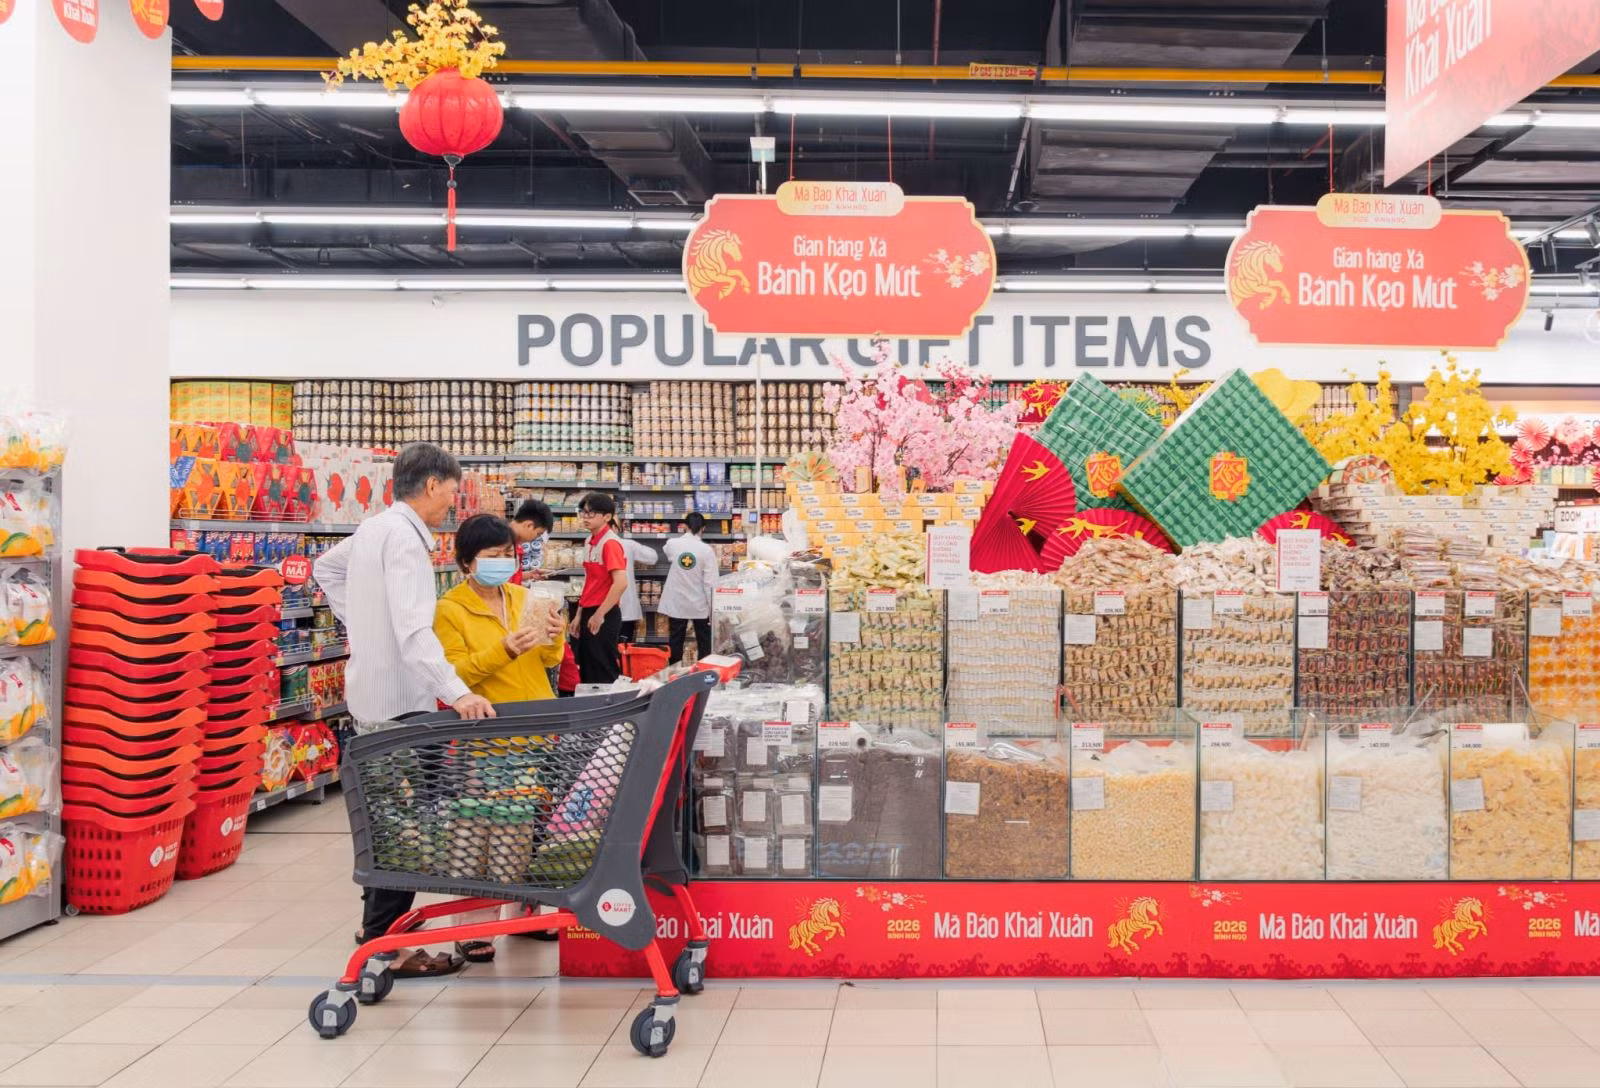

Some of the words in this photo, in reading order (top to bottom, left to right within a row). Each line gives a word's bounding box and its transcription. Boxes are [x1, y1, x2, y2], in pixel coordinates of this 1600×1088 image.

[1403, 14, 1440, 100] Khai
[793, 235, 823, 257] Gian
[1332, 247, 1363, 269] Gian
[757, 261, 816, 296] Bánh
[823, 262, 868, 300] Kẹo
[874, 263, 922, 298] Mứt
[1298, 272, 1356, 307] Bánh
[1361, 274, 1405, 312] Kẹo
[1411, 275, 1459, 310] Mứt
[517, 313, 830, 367] POPULAR
[1012, 315, 1212, 368] ITEMS
[654, 913, 679, 939] áo
[728, 912, 773, 939] Xuân
[887, 919, 921, 932] 2026
[933, 912, 960, 939] Mã
[966, 912, 999, 939] Đáo
[1004, 911, 1043, 939] Khai
[1048, 912, 1093, 939] Xuân
[1213, 920, 1247, 933] 2026
[1259, 913, 1286, 940] Mã
[1291, 913, 1324, 940] Đáo
[1329, 912, 1368, 940] Khai
[1373, 913, 1418, 940] Xuân
[1528, 917, 1562, 930] 2026
[1574, 910, 1600, 937] Mã
